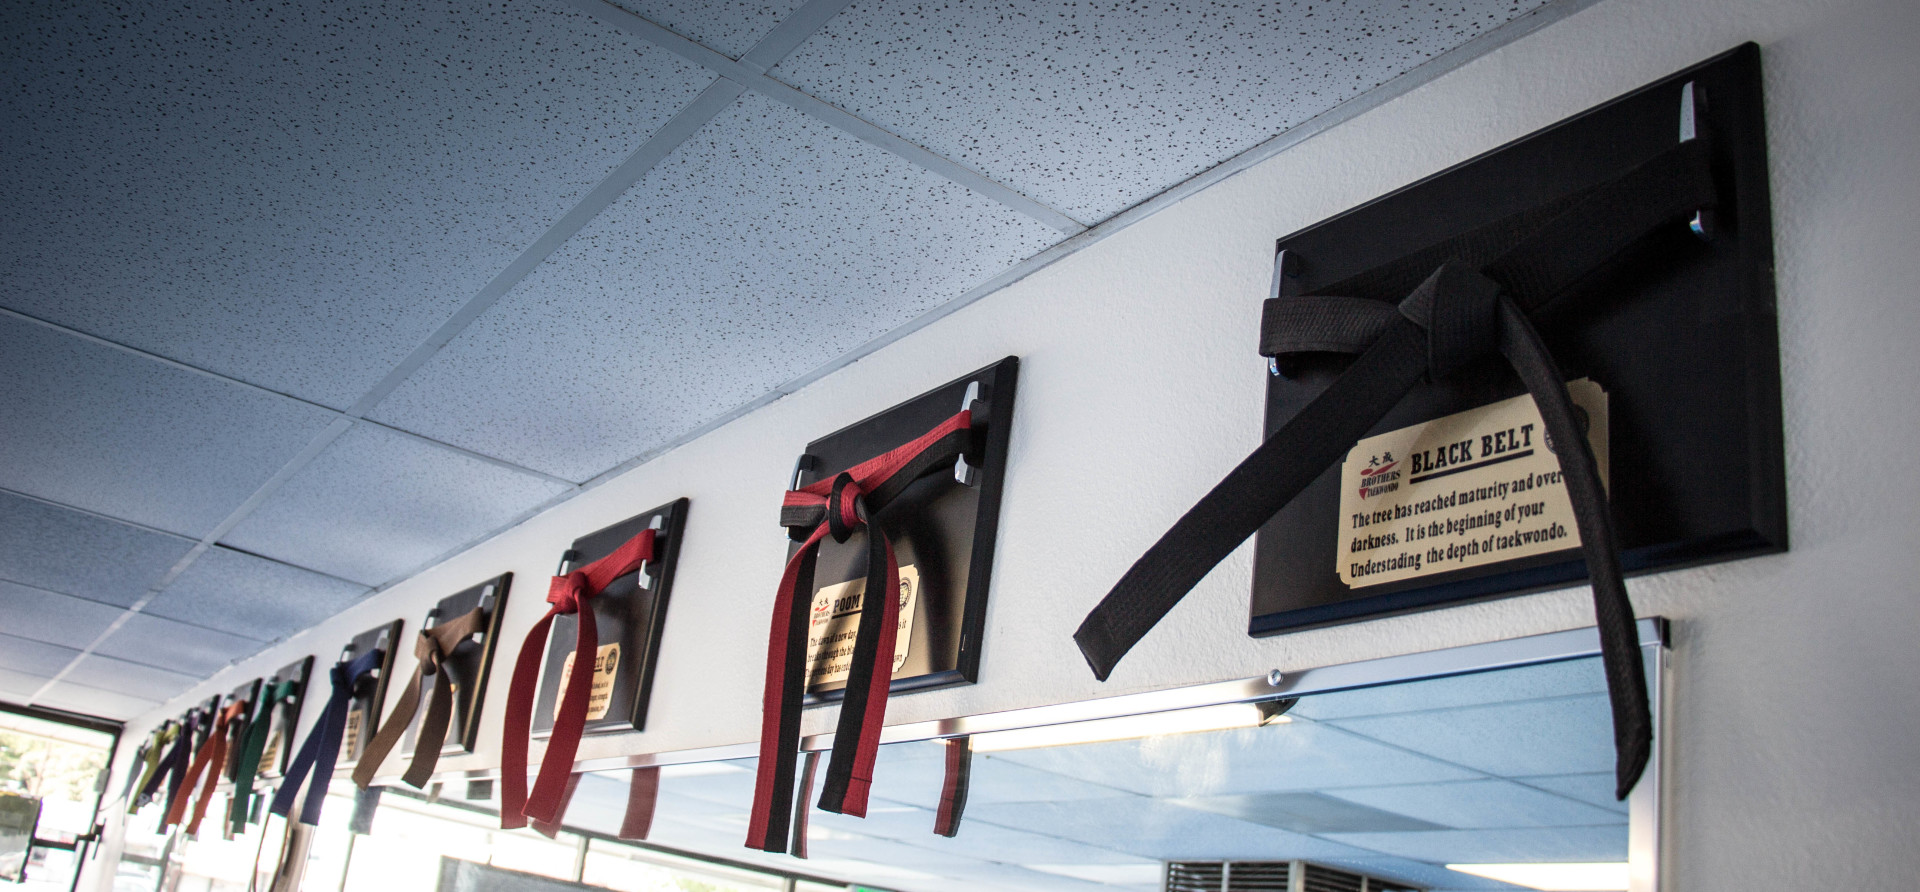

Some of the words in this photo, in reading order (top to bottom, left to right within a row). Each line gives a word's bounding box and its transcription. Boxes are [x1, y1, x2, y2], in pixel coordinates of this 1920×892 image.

[1411, 440, 1472, 475] BLACK
[1481, 423, 1533, 457] BELT
[1352, 512, 1370, 528] The
[1372, 509, 1392, 524] tree
[1394, 504, 1412, 519] has
[1414, 490, 1456, 517] reached
[1458, 481, 1509, 505] maturity
[1511, 473, 1533, 493] and
[1361, 470, 1401, 488] BROTHERS
[1367, 482, 1399, 498] TAEKWONDO
[1350, 552, 1421, 579] Understading
[1427, 547, 1444, 564] the
[1447, 538, 1479, 562] depth
[1482, 534, 1494, 552] of
[1496, 522, 1567, 550] taekwondo.
[1351, 532, 1399, 553] darkness.
[1405, 527, 1414, 542] It
[1417, 524, 1425, 540] is
[1428, 520, 1444, 537] the
[1446, 510, 1501, 536] beginning
[1504, 503, 1516, 521] of
[1518, 501, 1545, 524] your
[833, 593, 861, 613] POOM
